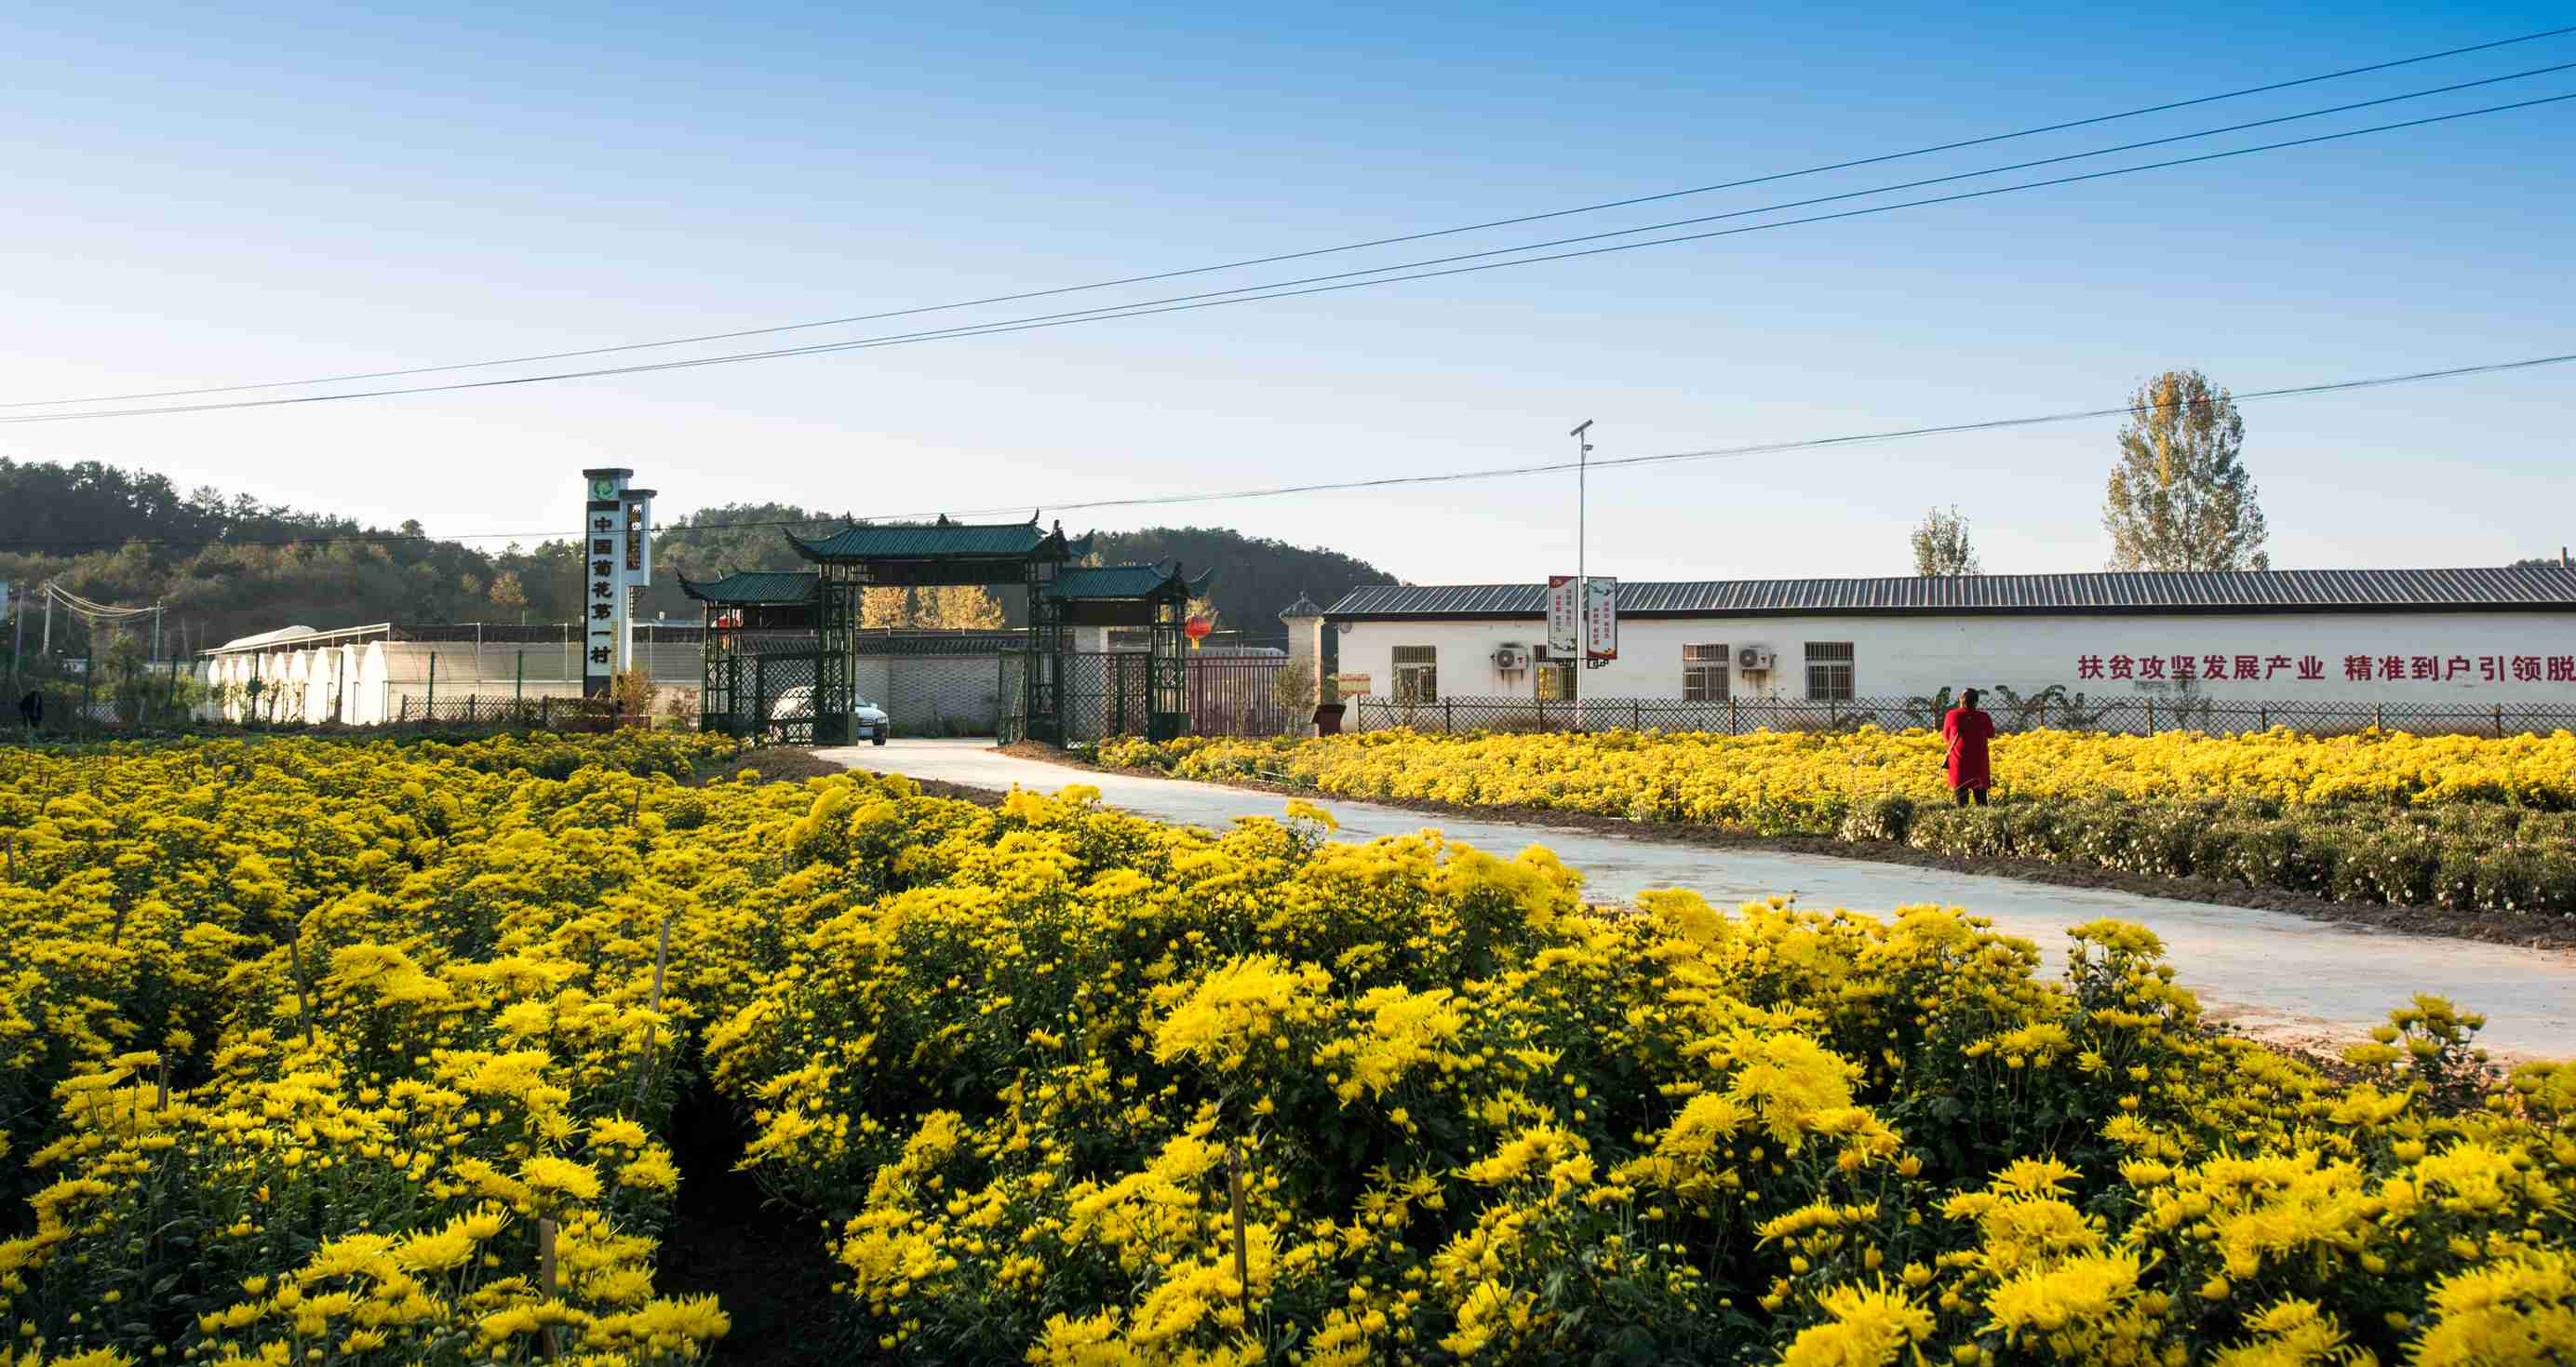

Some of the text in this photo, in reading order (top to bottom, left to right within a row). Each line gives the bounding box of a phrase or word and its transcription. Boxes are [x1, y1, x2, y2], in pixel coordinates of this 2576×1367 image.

[2078, 655, 2576, 681] 扶贫攻坚发展产业 精准到户引领脱
